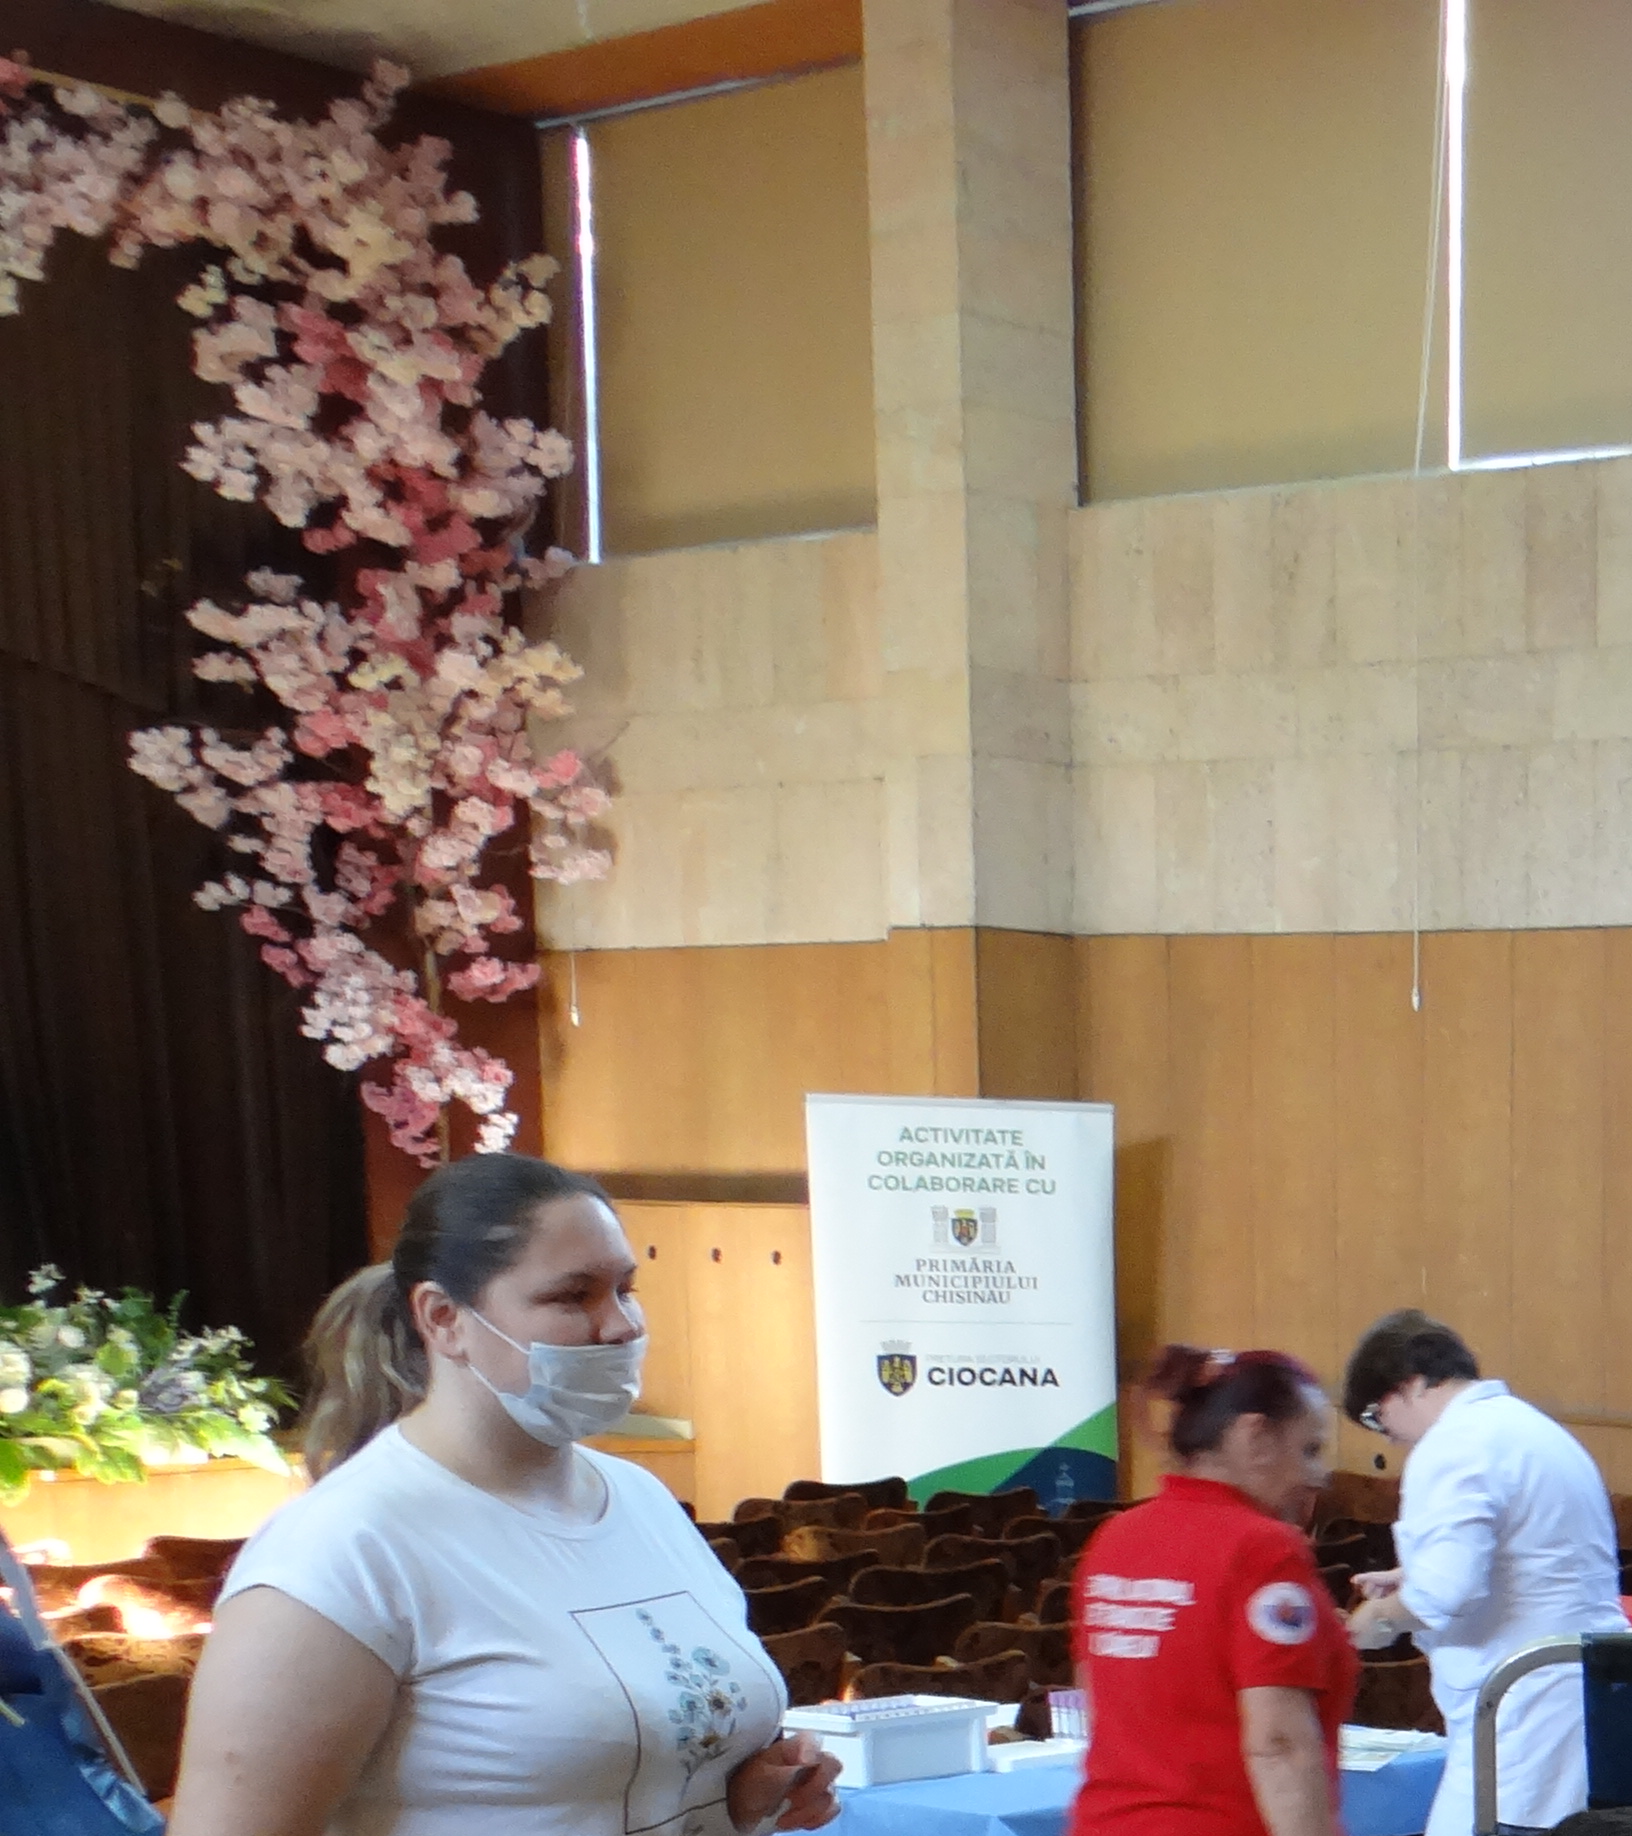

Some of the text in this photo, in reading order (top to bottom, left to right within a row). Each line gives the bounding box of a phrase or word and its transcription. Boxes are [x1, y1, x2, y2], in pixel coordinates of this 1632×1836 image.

[899, 1126, 1024, 1147] ACTIVITATE
[876, 1149, 1046, 1171] ORGANIZATĂ ÎN
[867, 1174, 1057, 1195] COLABORARE CU
[914, 1256, 1017, 1274] PRIMĂRIA
[894, 1273, 1039, 1290] MUNICIPIULUI
[927, 1366, 1060, 1387] CIOCANA
